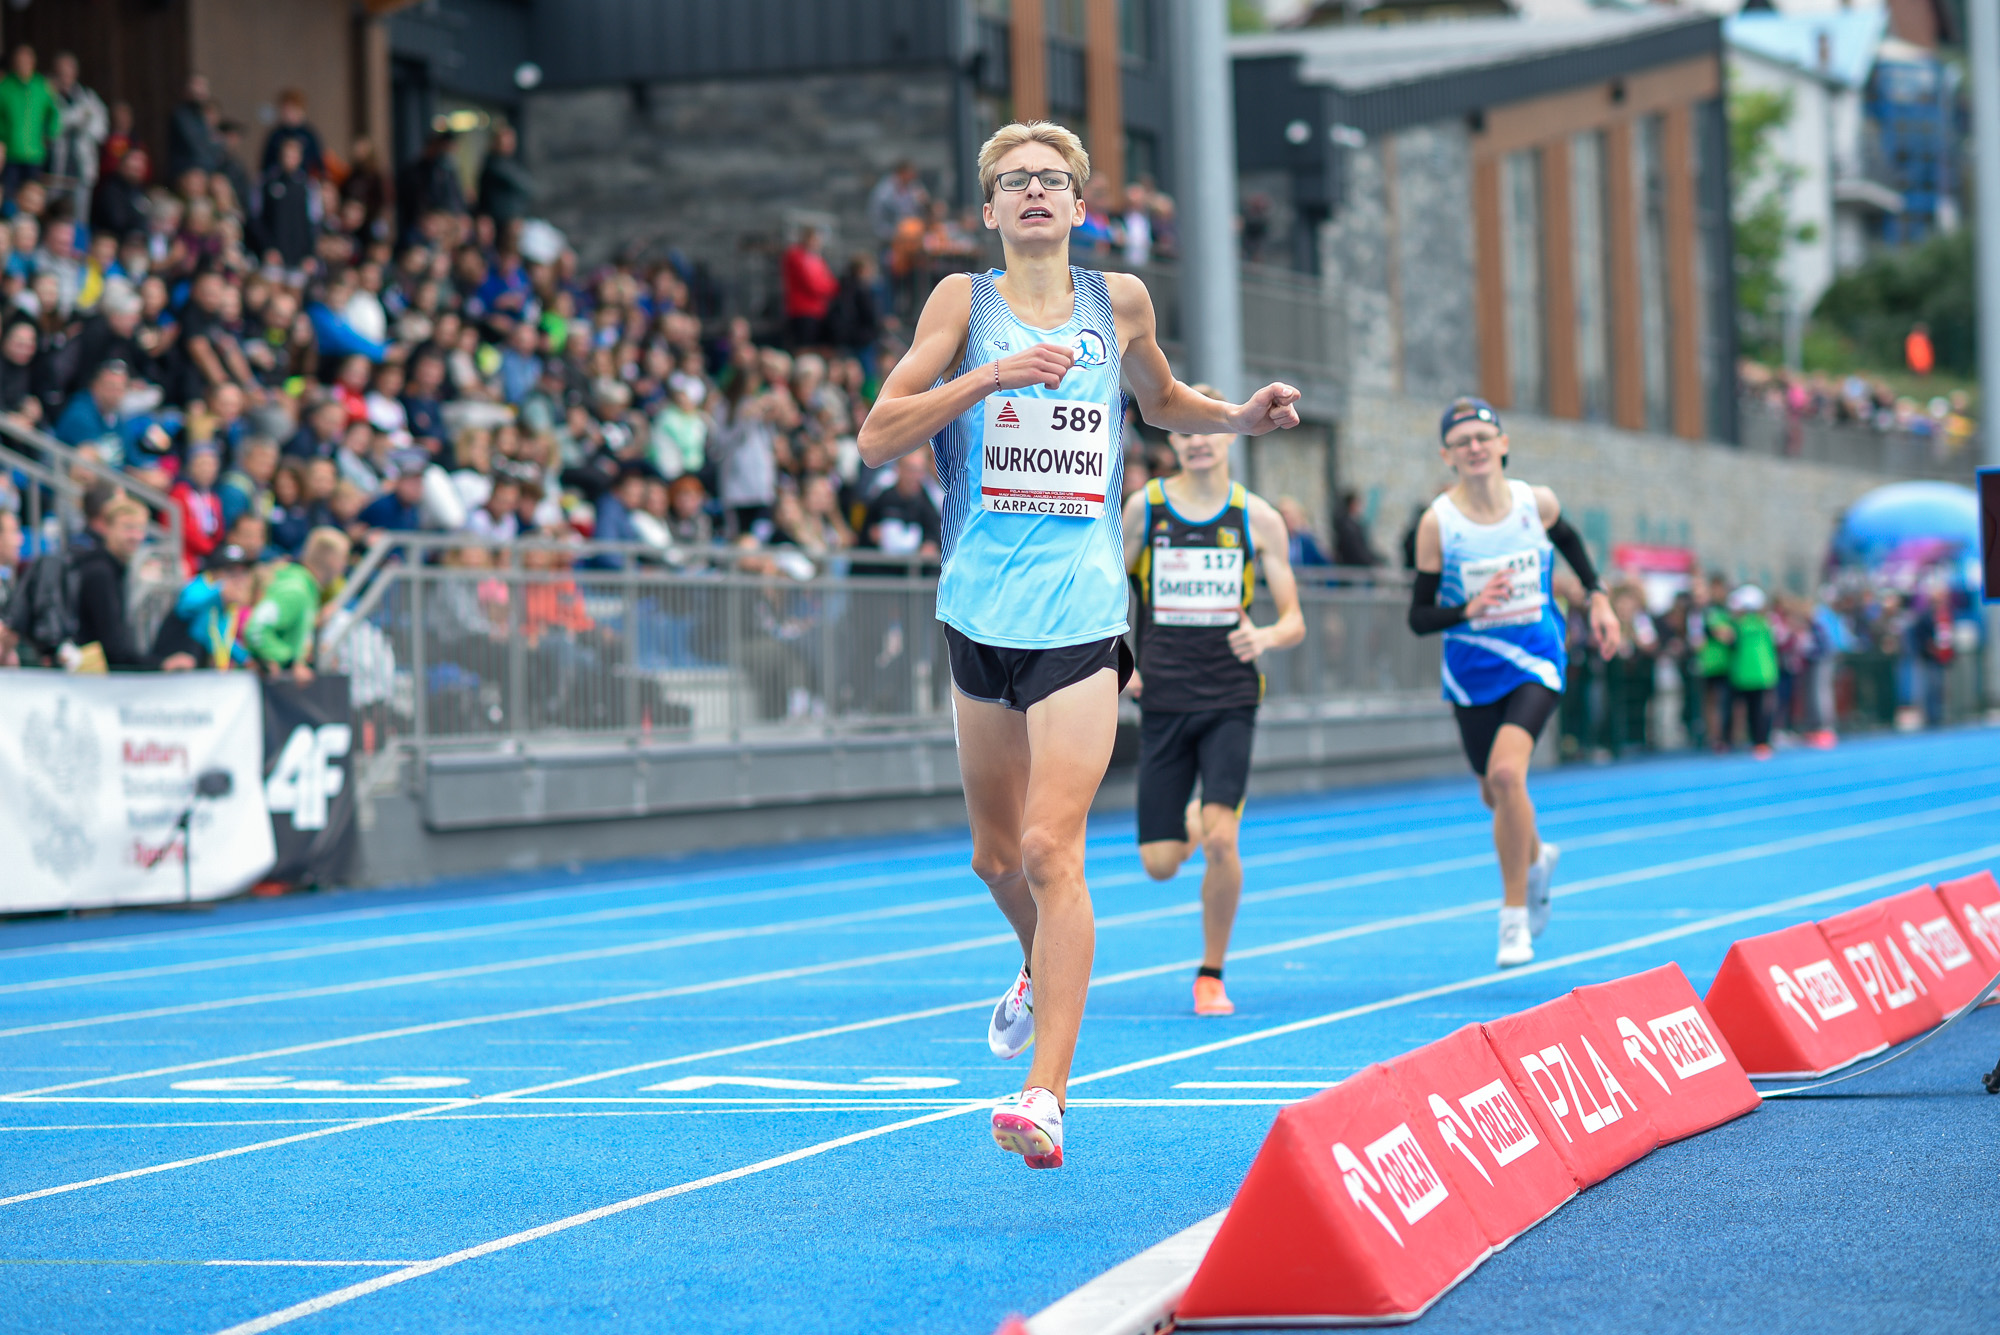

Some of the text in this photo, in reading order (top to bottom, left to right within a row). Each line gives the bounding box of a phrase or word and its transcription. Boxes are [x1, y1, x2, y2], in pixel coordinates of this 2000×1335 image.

[1051, 406, 1102, 433] 589
[985, 445, 1103, 477] NURKOWSKI
[993, 499, 1089, 515] KARPACZ 2021
[1159, 576, 1237, 597] ŚMIERTKA
[1204, 554, 1237, 569] 117
[264, 723, 352, 830] 4F
[1843, 934, 1929, 1015] PZLA
[1658, 1016, 1718, 1068] ORLEN
[1519, 1034, 1639, 1144] PZLA
[1470, 1090, 1531, 1154] ORLEN
[1377, 1137, 1439, 1209] ORLEN
